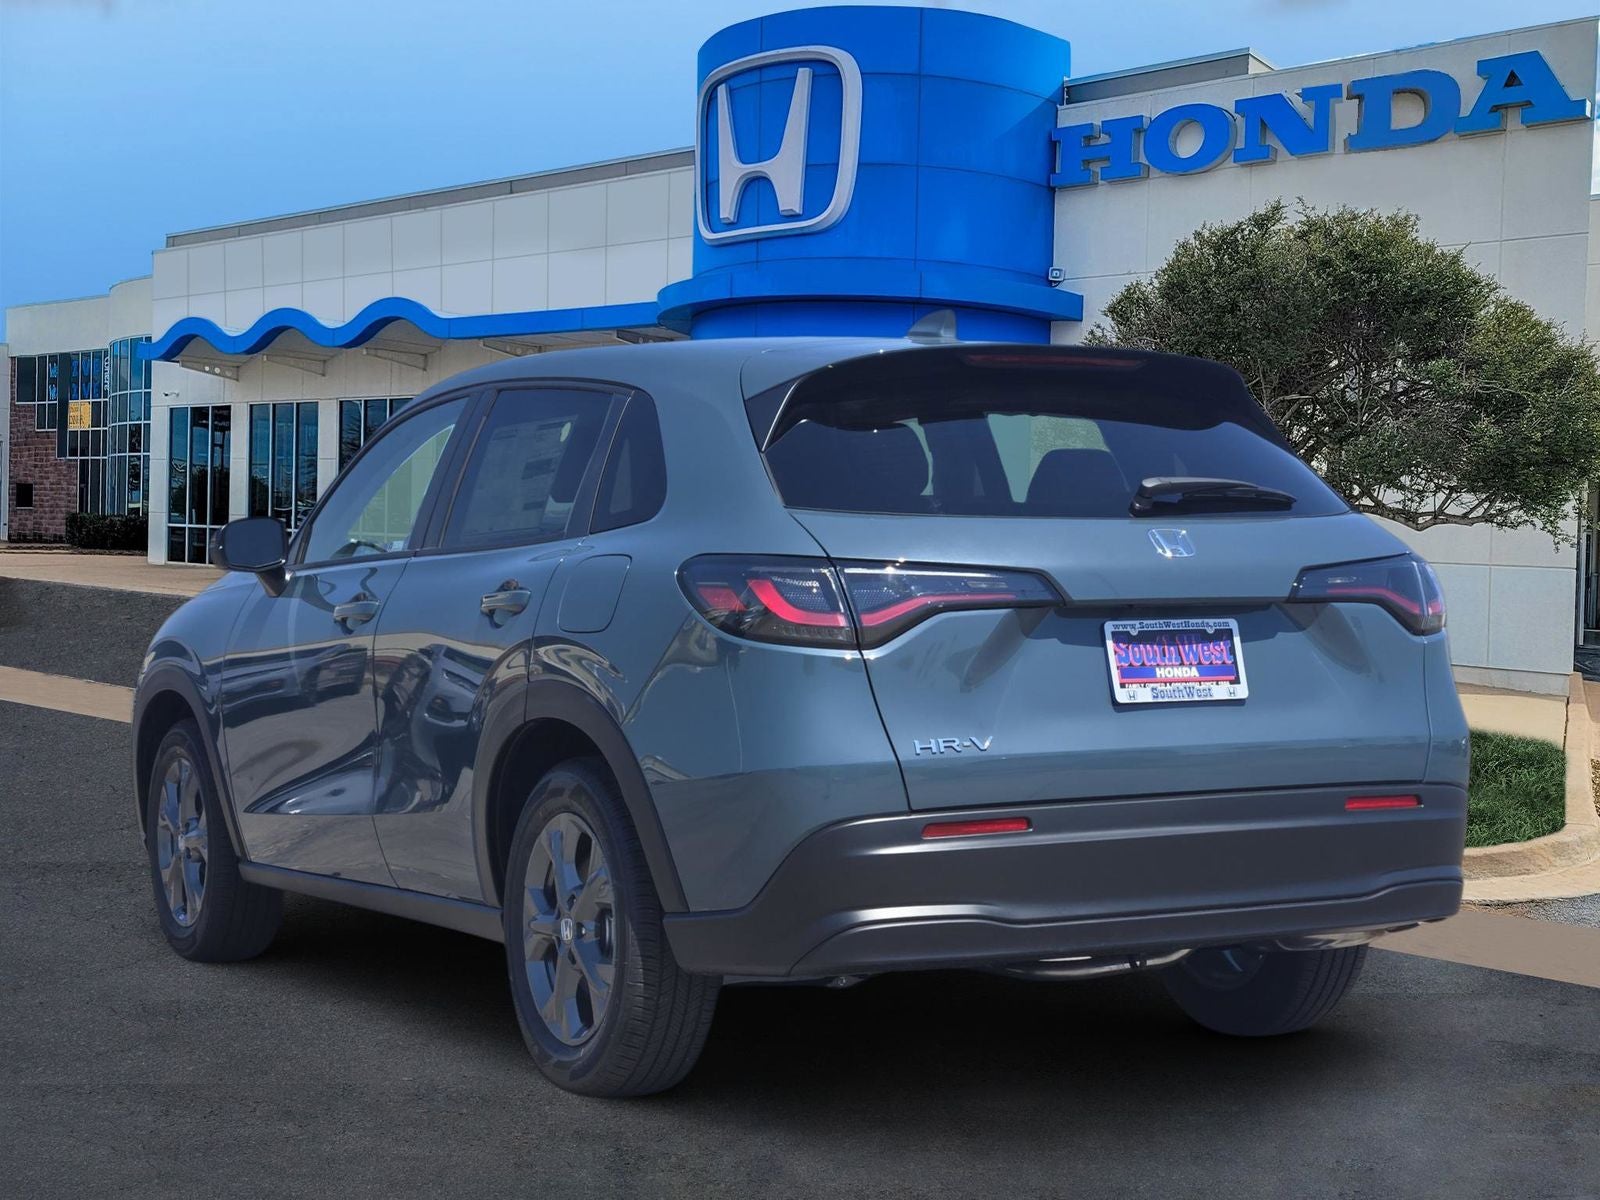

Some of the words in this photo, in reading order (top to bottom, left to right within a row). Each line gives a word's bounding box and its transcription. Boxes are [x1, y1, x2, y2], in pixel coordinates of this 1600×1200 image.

[1050, 50, 1592, 188] HONDA
[1112, 620, 1230, 631] www.SouthWestHonda.com
[1155, 666, 1200, 678] HONDA
[1151, 685, 1214, 699] SouthWest
[913, 735, 993, 756] HR-V
